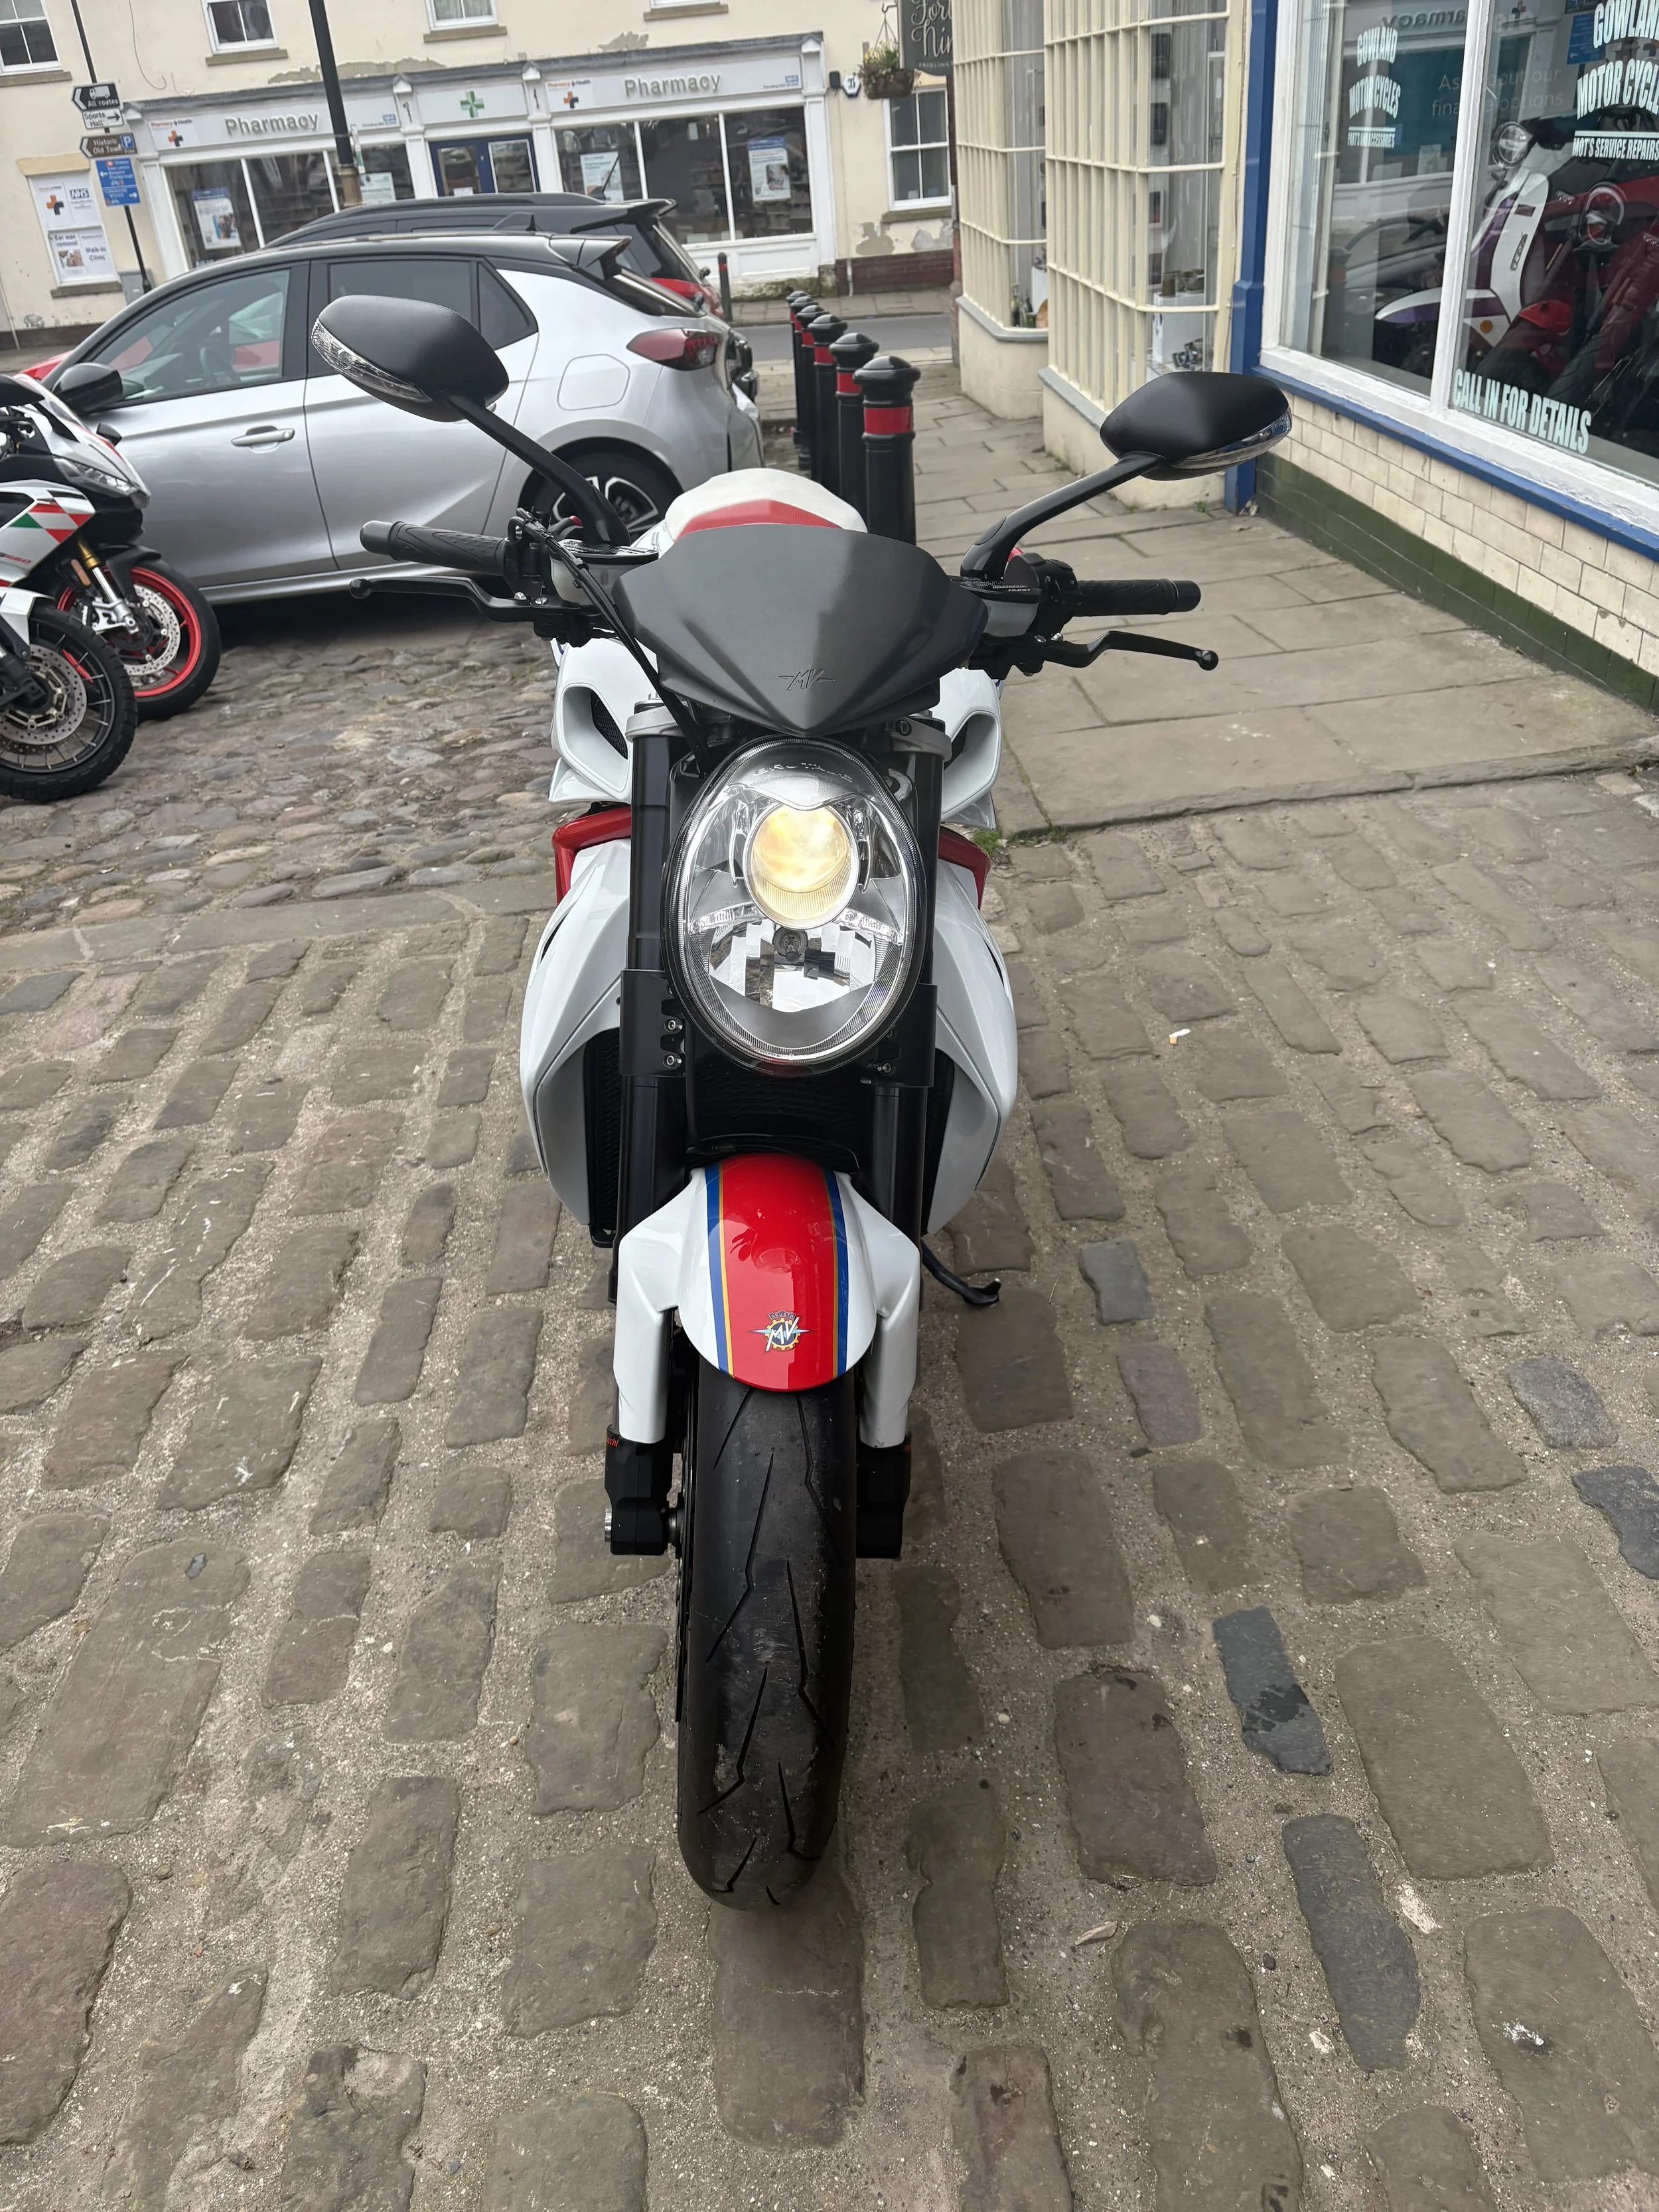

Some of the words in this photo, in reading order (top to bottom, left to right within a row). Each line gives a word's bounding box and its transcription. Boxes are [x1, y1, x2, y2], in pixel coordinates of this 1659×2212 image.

[1356, 26, 1398, 67] GOWLAND
[624, 74, 721, 100] Pharmacy
[1439, 74, 1459, 91] As
[1577, 60, 1623, 120] MOTOR
[88, 99, 97, 108] All
[1349, 76, 1374, 119] MOTOR
[1374, 74, 1401, 119] CYCLES
[84, 111, 106, 120] Sports
[224, 113, 319, 136] Pharmacy
[93, 145, 105, 154] Old
[123, 135, 131, 149] P
[1572, 137, 1595, 158] MOT'S
[1595, 138, 1627, 159] SERVICE
[1626, 139, 1659, 161] REPAIRS
[70, 188, 89, 198] NHS
[1453, 368, 1482, 414] CALL
[1483, 378, 1500, 419] IN
[1500, 384, 1529, 431] FOR
[1528, 394, 1591, 454] DETAILS
[765, 1316, 800, 1352] MV
